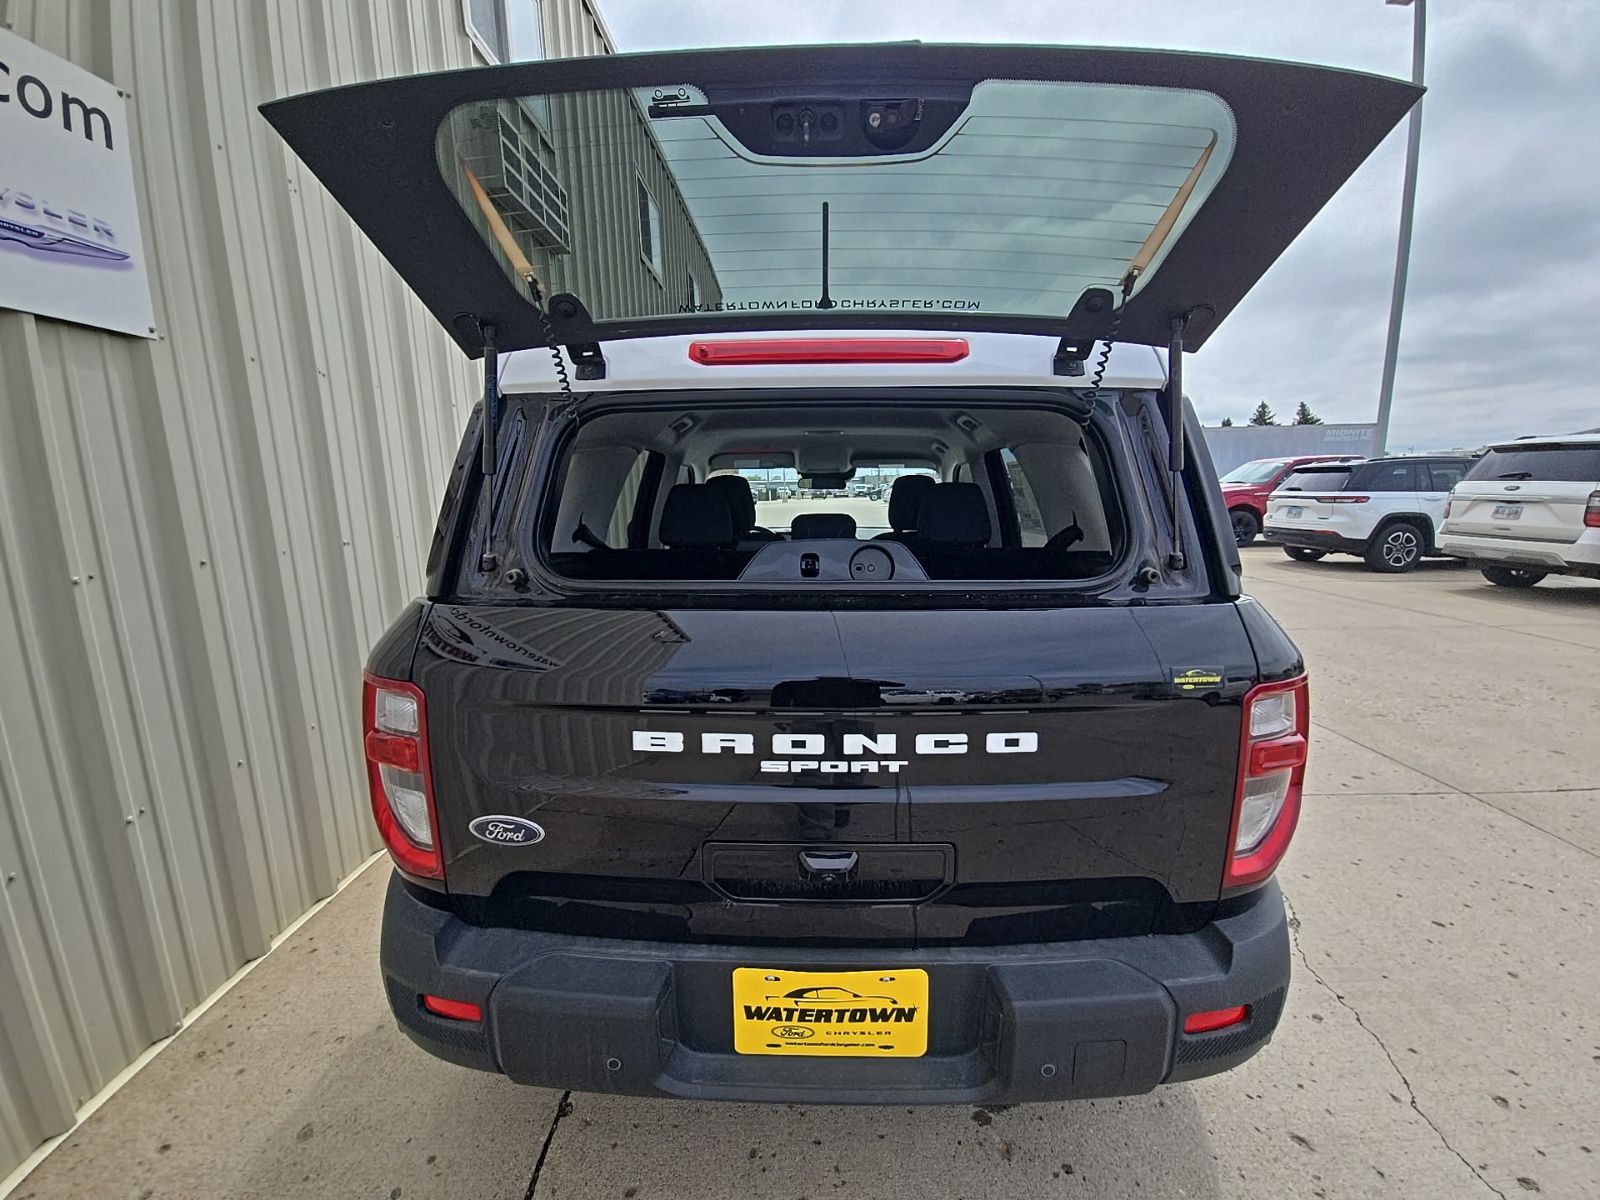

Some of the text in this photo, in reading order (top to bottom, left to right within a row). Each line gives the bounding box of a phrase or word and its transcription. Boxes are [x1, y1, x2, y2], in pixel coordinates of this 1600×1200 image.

[632, 730, 1038, 755] BRONCO
[760, 760, 909, 773] SPORT
[485, 822, 525, 841] Ford
[743, 1005, 915, 1023] WATERTOWN
[780, 1026, 805, 1038] Ford
